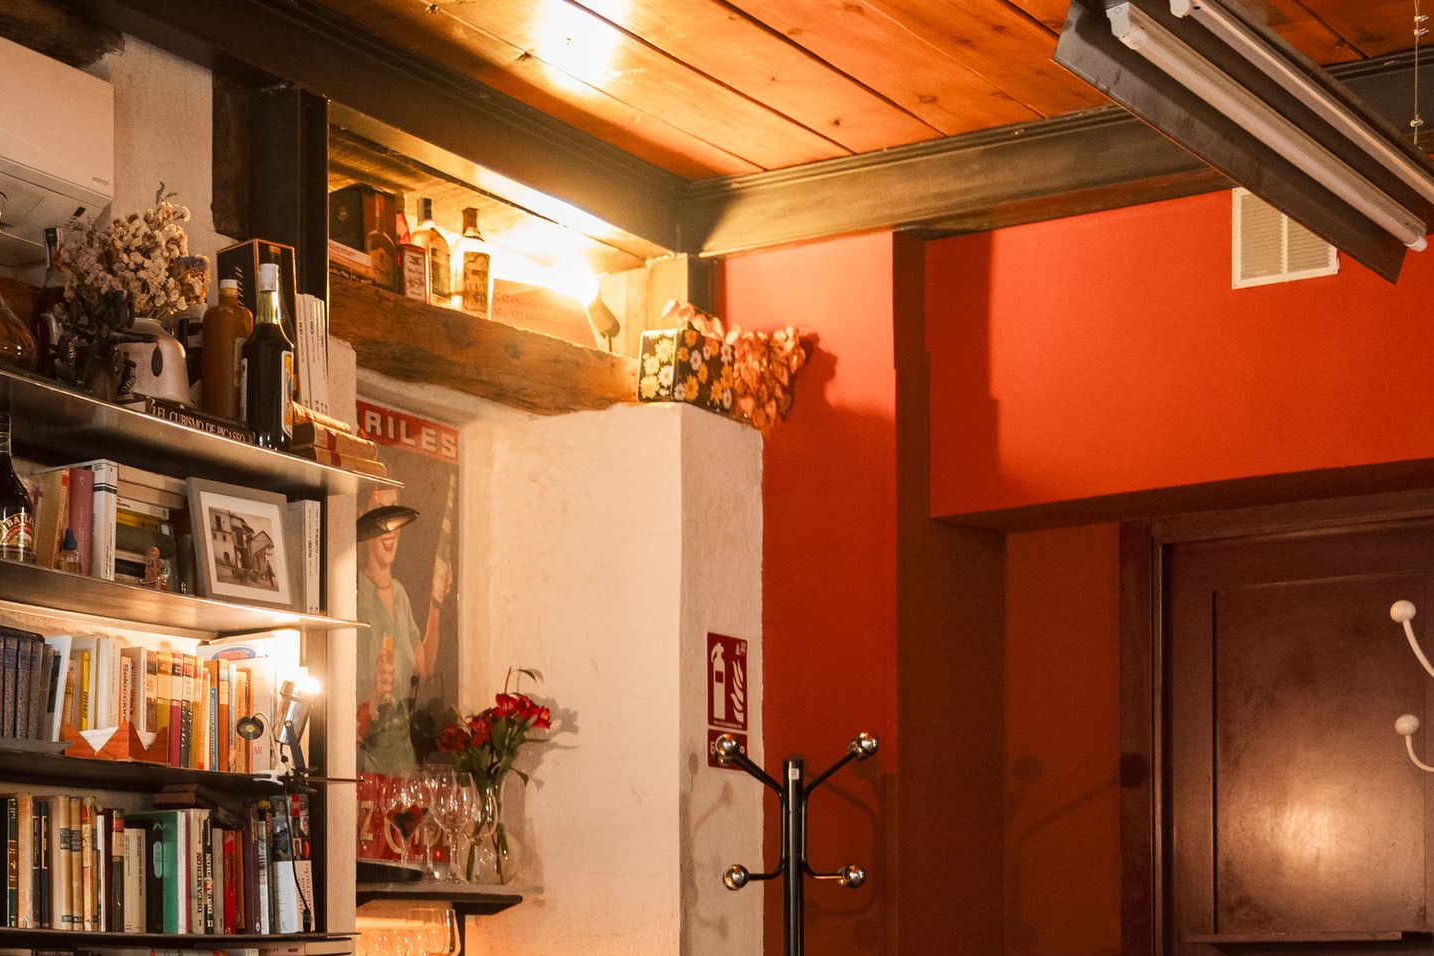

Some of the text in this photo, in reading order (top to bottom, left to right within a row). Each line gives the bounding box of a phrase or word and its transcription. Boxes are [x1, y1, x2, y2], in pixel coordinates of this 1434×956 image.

[156, 405, 166, 420] EL
[169, 410, 204, 431] CUBISMO
[205, 421, 217, 433] DE
[364, 409, 457, 459] RILES
